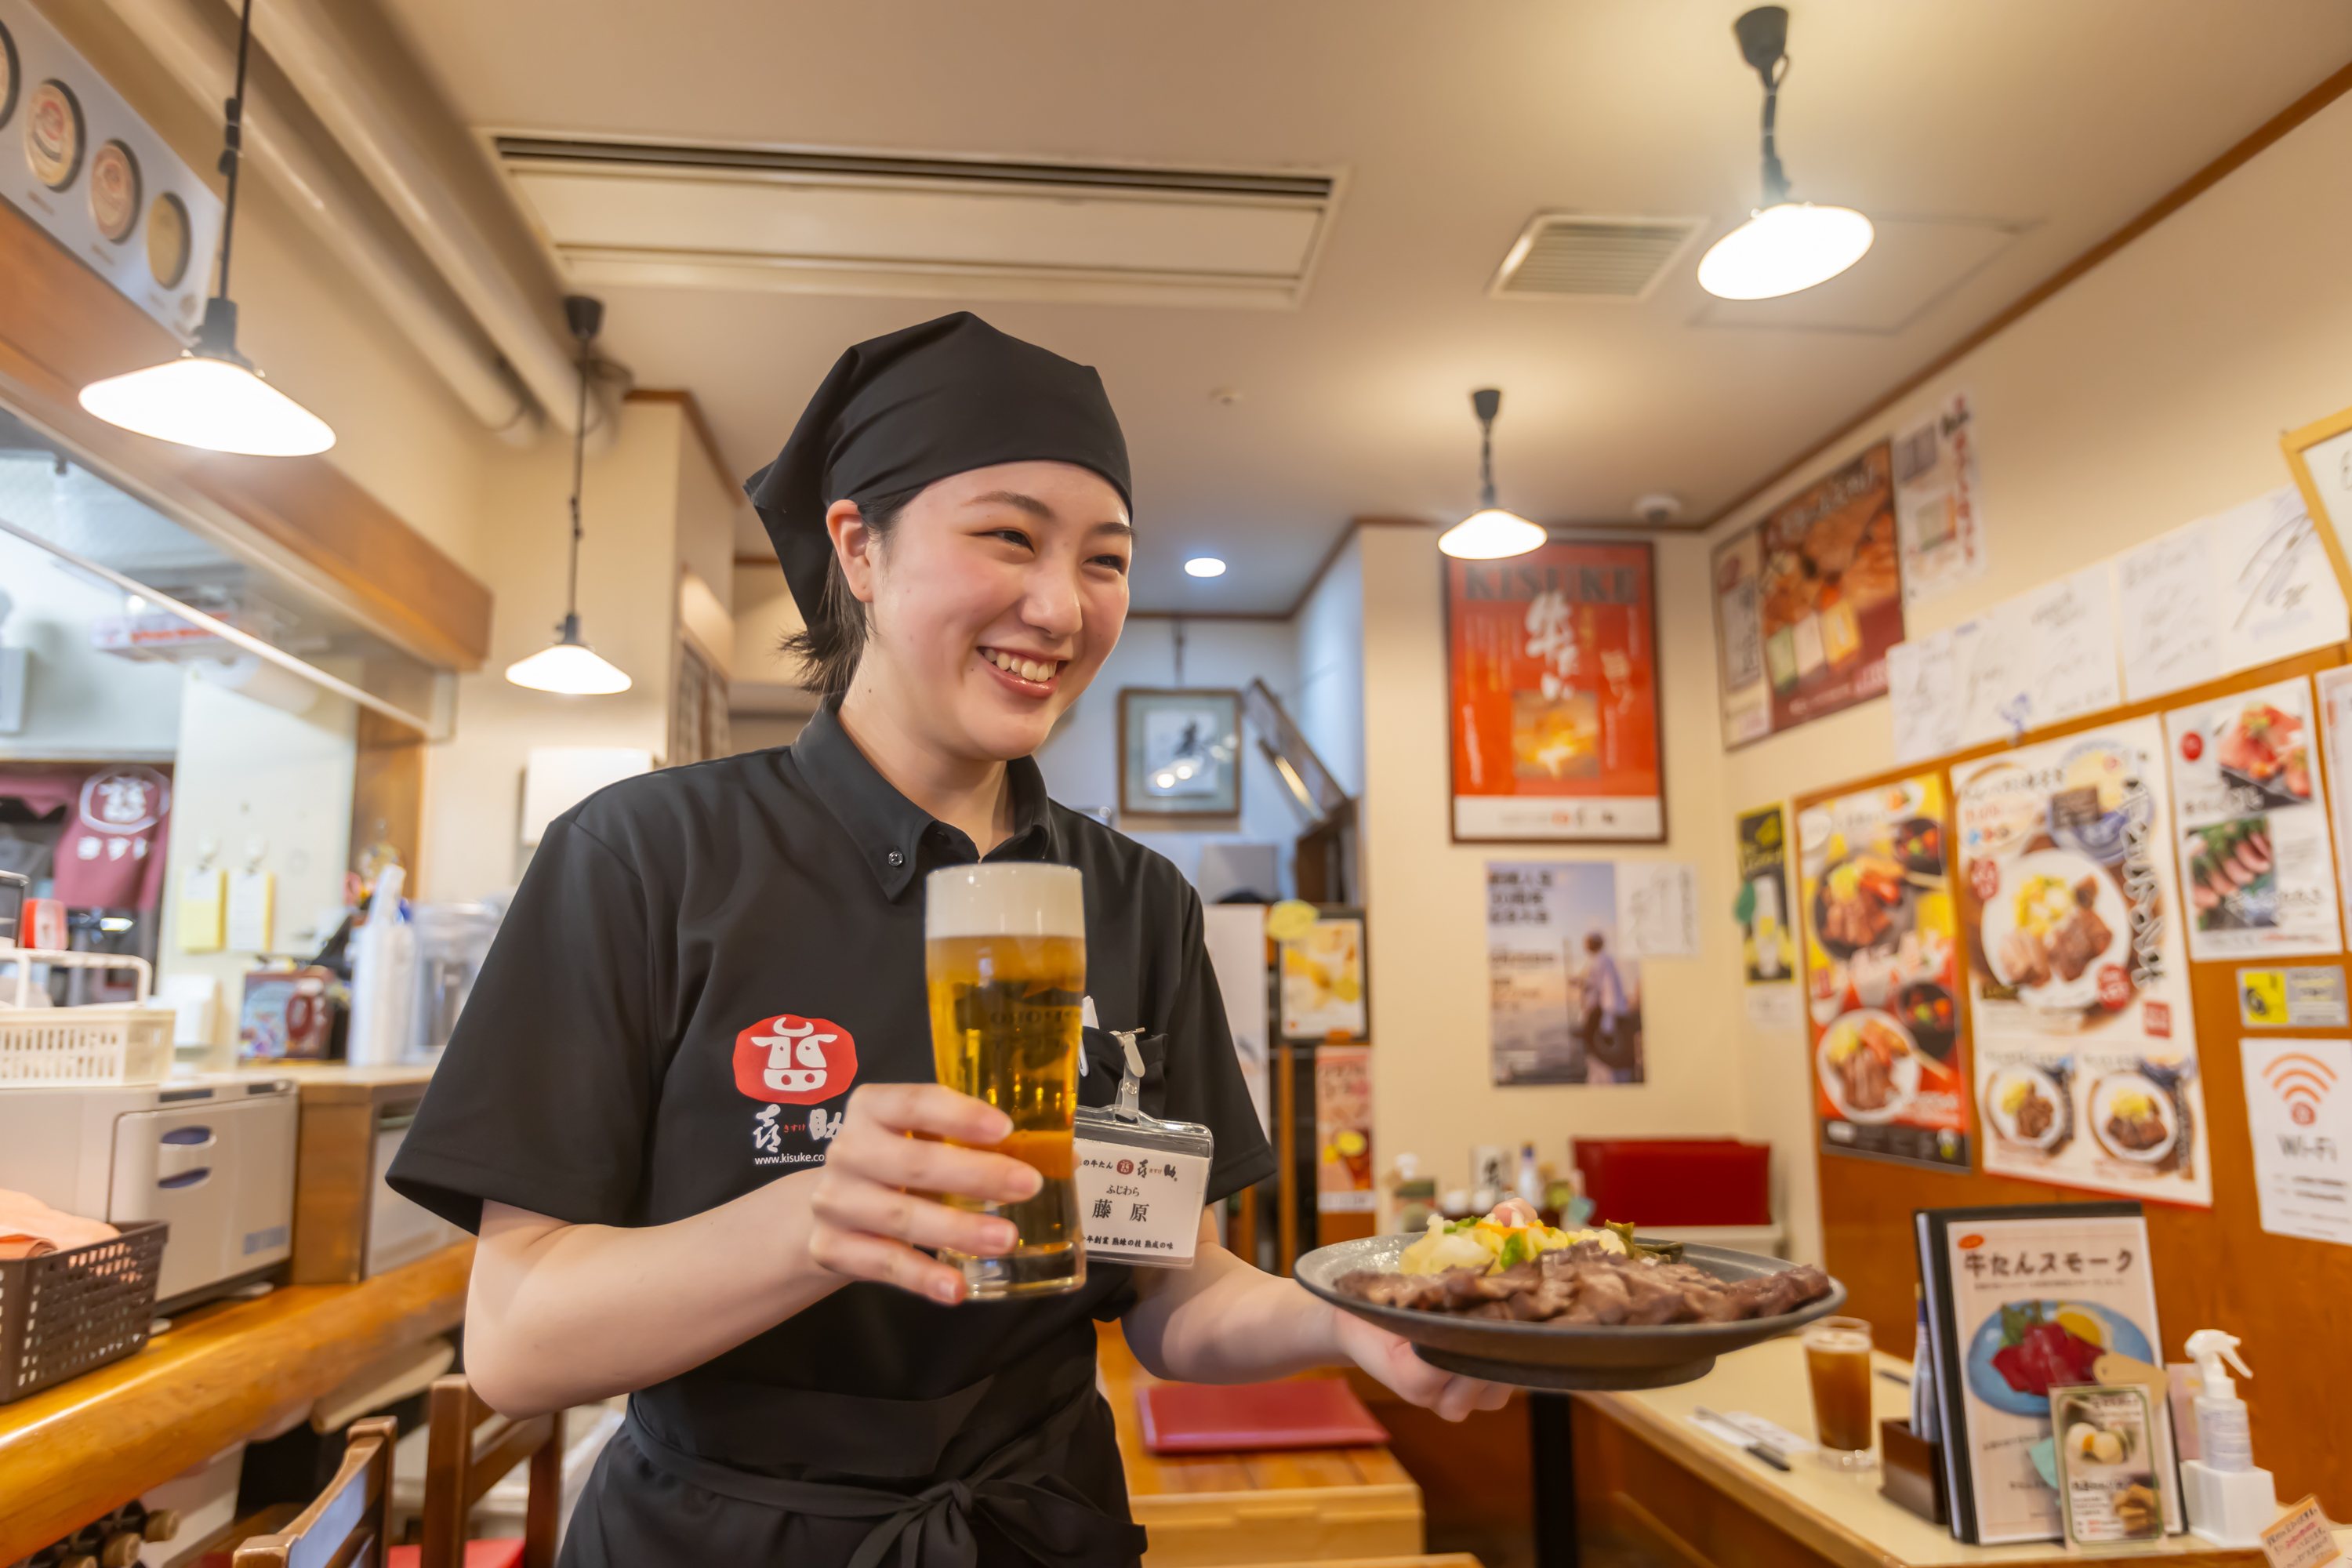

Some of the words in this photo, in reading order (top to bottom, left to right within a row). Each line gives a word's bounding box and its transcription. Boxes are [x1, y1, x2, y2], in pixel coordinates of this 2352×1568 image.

[1081, 1160, 1113, 1169] の牛たん
[1105, 1185, 1140, 1197] ふじわら
[1083, 1235, 1109, 1245] 年創業
[1144, 1240, 1174, 1250] 熟成の味
[1963, 1248, 2133, 1279] 牛たんスモーク
